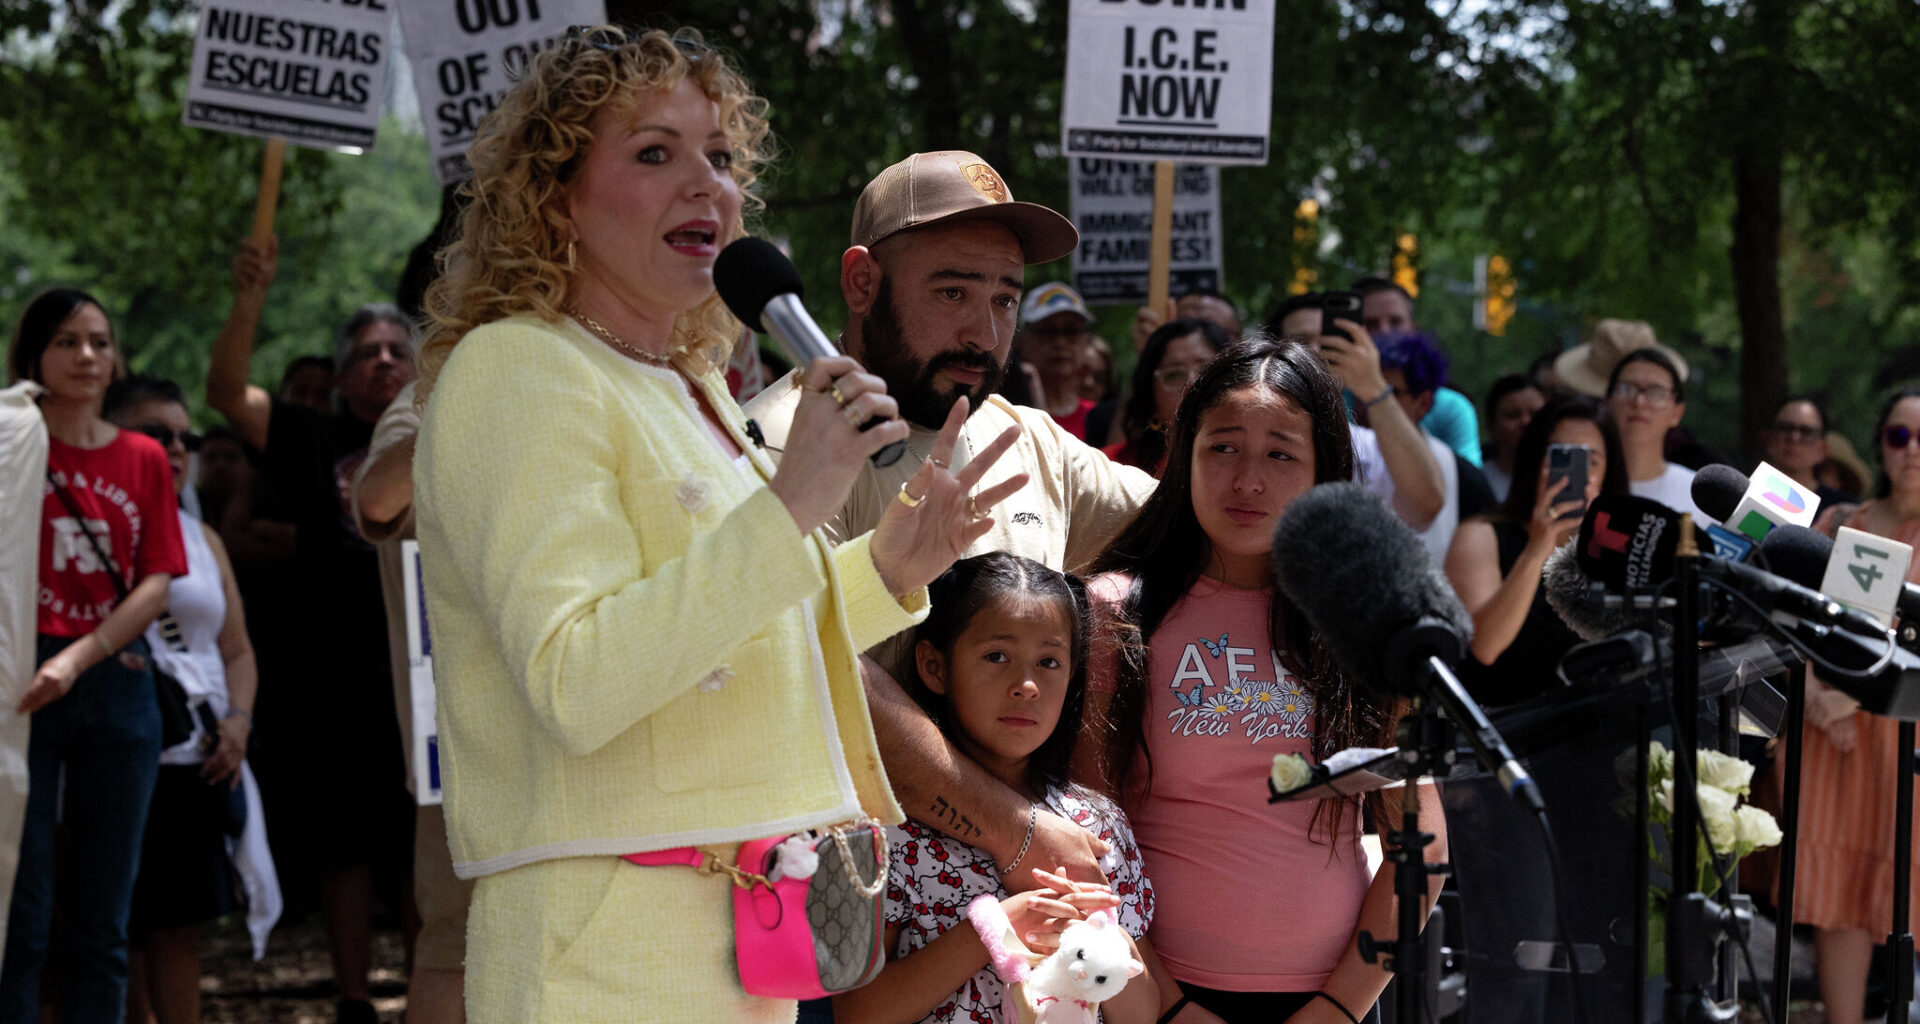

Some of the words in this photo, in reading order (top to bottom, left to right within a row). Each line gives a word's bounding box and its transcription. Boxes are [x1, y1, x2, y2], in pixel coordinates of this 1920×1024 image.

[206, 8, 381, 65] NUESTRAS
[1122, 26, 1228, 72] I.C.E.
[205, 51, 371, 104] ESCUELAS
[438, 53, 488, 97] OF
[1120, 74, 1221, 119] NOW
[1093, 136, 1120, 151] Party
[1080, 211, 1210, 233] IMMIGANT
[1081, 237, 1211, 263] FAMIES!
[1626, 512, 1657, 588] NOTICIAS
[1848, 544, 1889, 593] 41
[1167, 707, 1231, 737] New
[1241, 711, 1310, 745] York
[930, 796, 982, 838] יהוה
